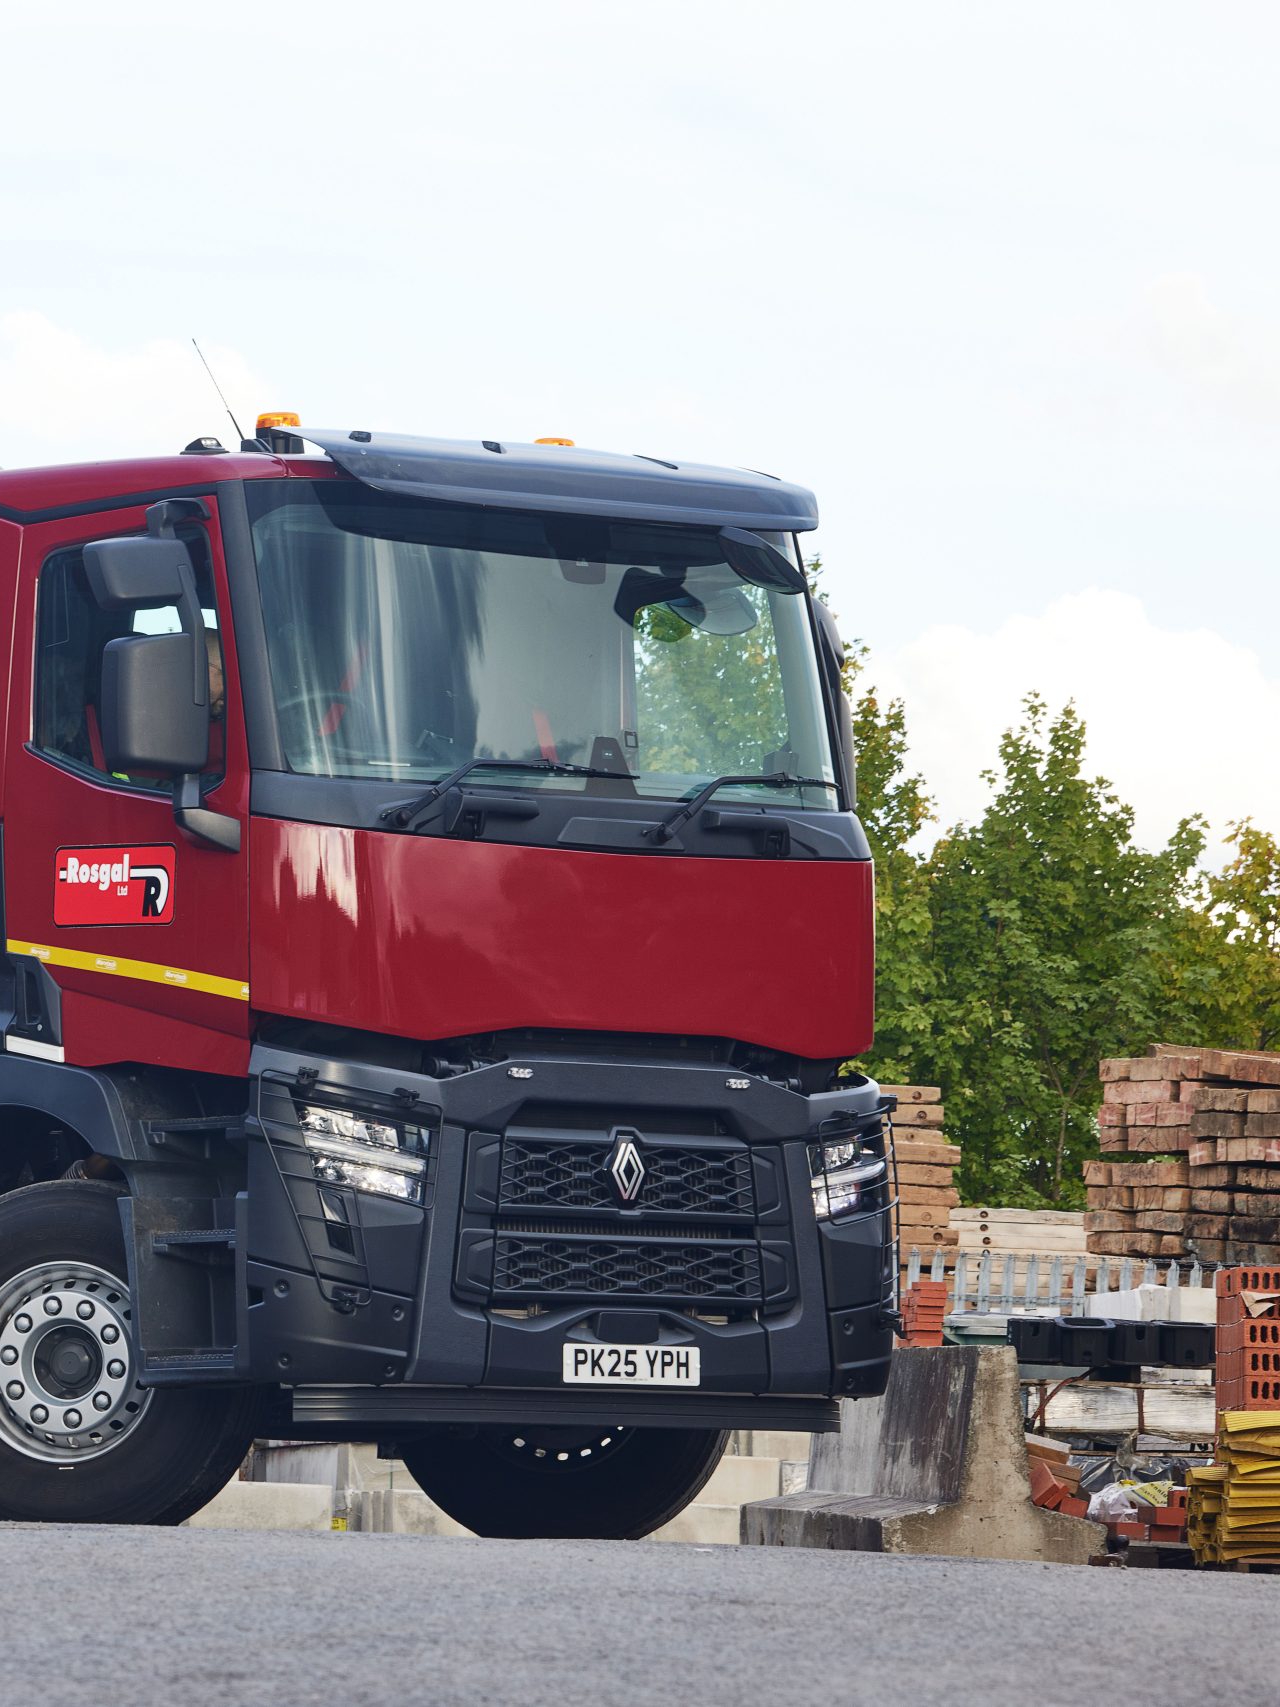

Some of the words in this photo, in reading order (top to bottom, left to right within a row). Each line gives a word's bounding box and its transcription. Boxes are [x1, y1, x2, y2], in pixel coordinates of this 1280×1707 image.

[67, 853, 130, 891] Rosgal
[117, 885, 128, 896] Ltd
[573, 1348, 638, 1378] PK25
[645, 1349, 690, 1379] YPH
